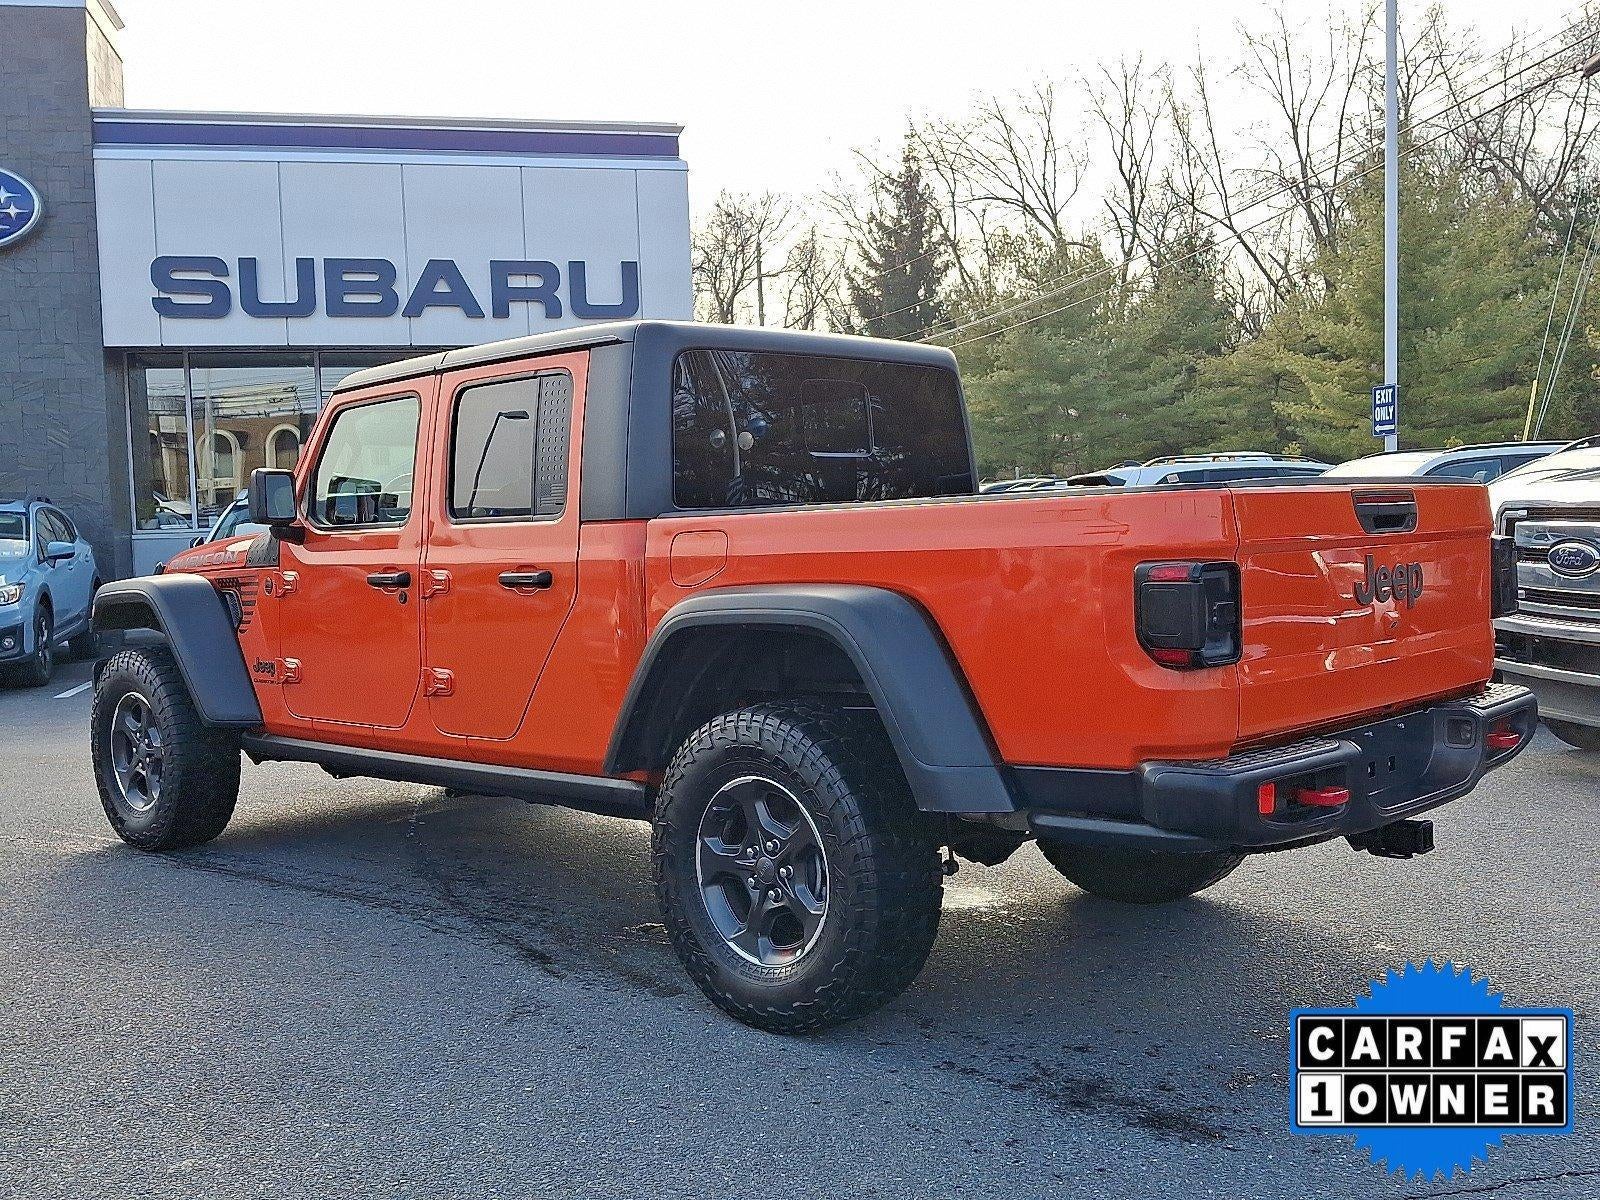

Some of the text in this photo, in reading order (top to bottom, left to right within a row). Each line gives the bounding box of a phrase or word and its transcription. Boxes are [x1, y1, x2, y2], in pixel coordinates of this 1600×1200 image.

[150, 255, 640, 319] SUBARU
[1375, 388, 1394, 404] EXIT
[1374, 405, 1395, 422] ONLY
[1555, 547, 1585, 566] Ford
[1353, 554, 1424, 610] Jeep
[252, 656, 276, 678] Jeep
